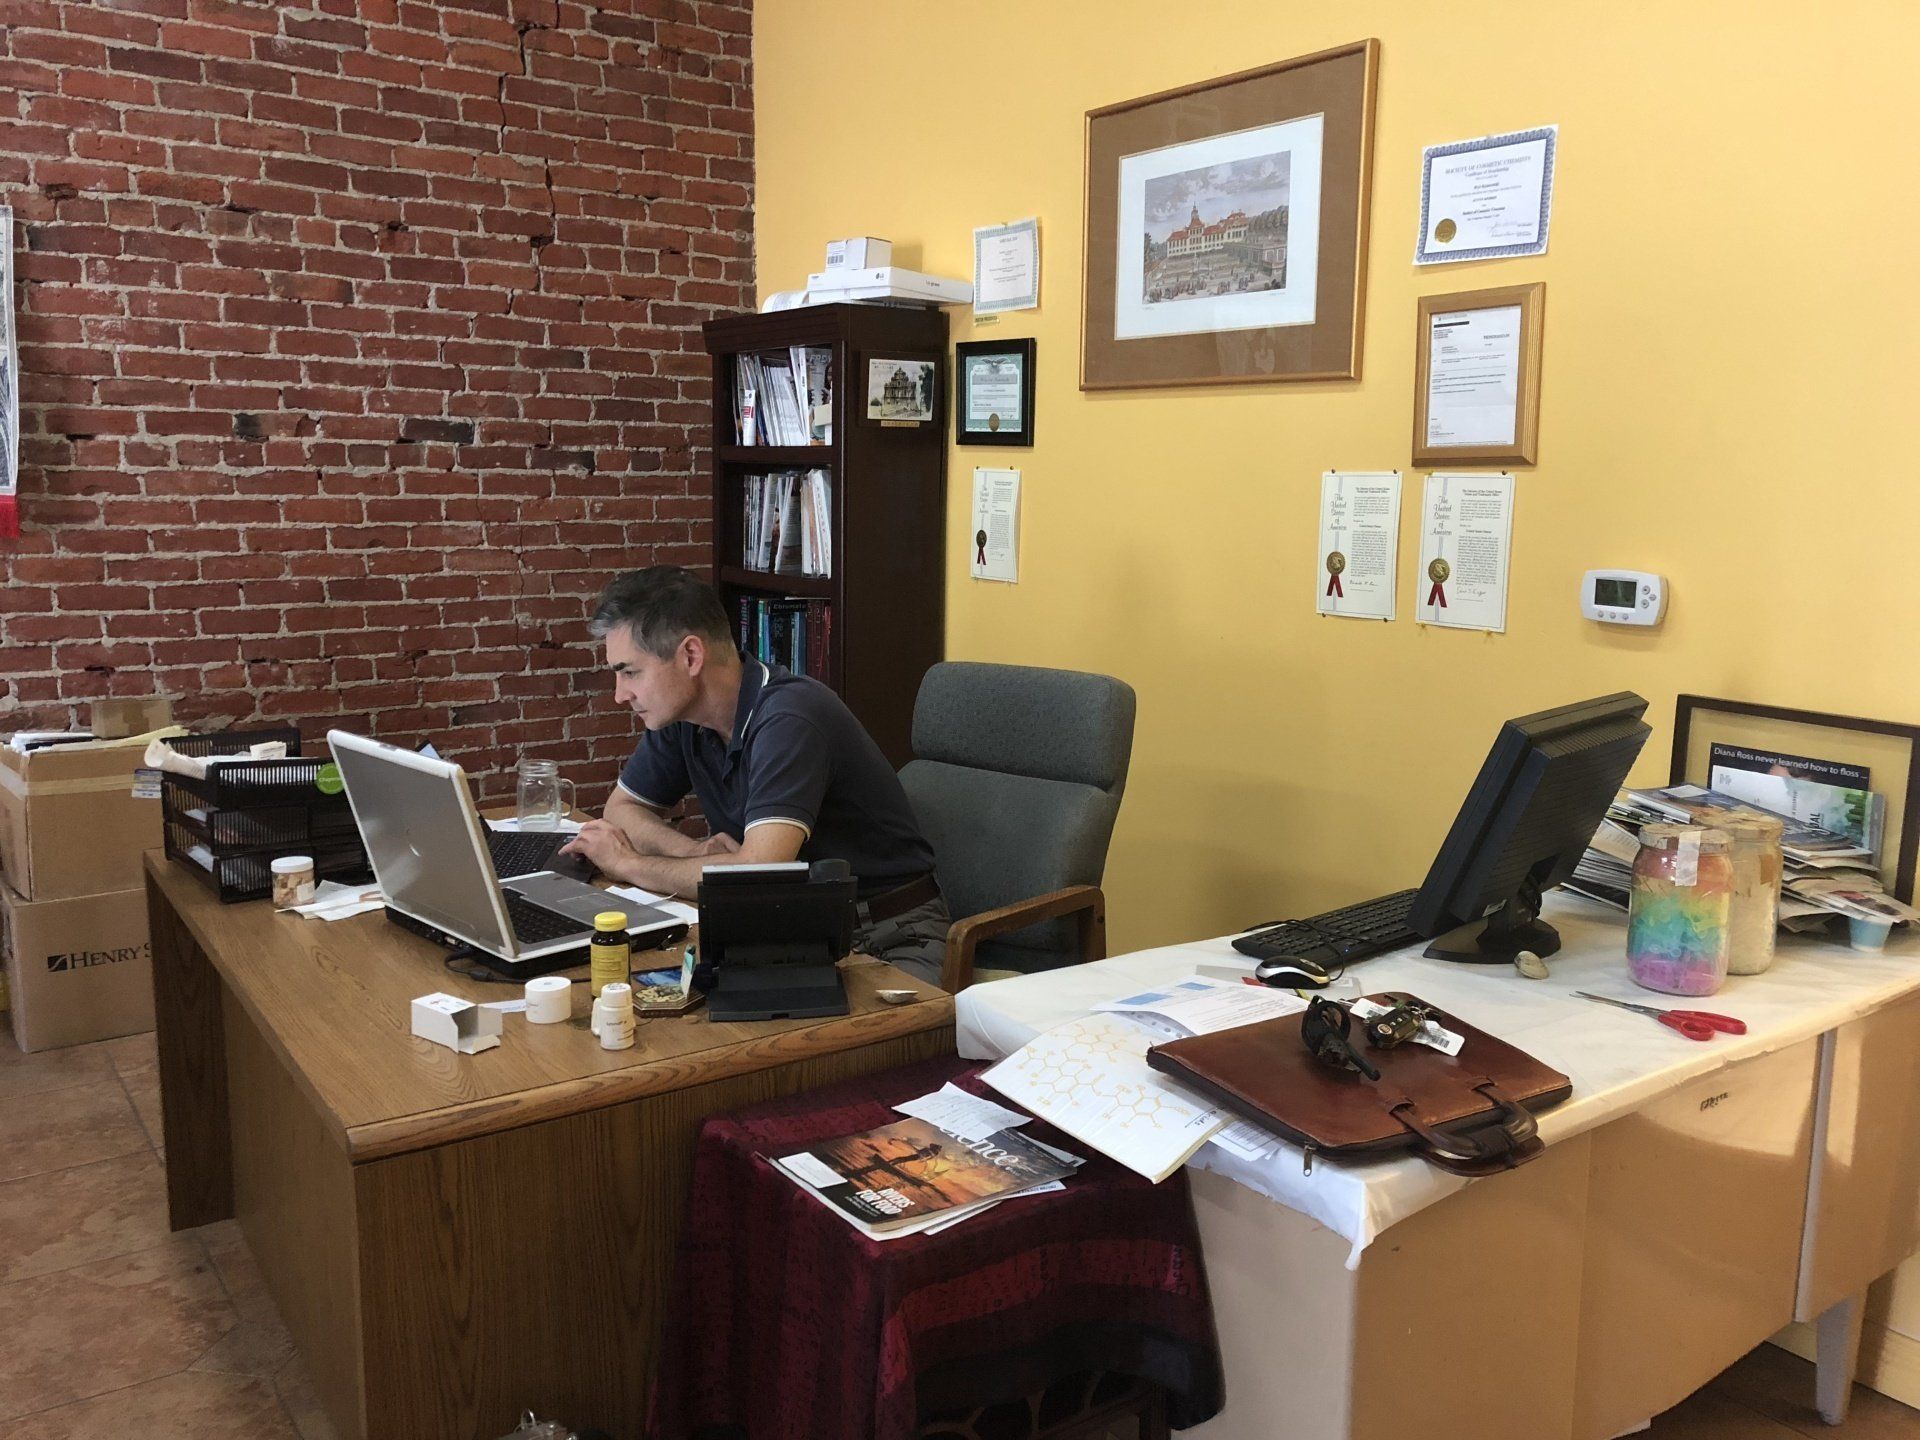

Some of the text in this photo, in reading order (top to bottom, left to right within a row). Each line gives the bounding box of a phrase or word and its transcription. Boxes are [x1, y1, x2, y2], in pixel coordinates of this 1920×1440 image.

[1714, 747, 1736, 757] Diana
[1736, 750, 1754, 760] Ross
[1755, 755, 1777, 764] never
[1778, 757, 1809, 769] learned
[1809, 762, 1827, 772] how
[1829, 767, 1839, 775] to
[1840, 767, 1859, 778] floss
